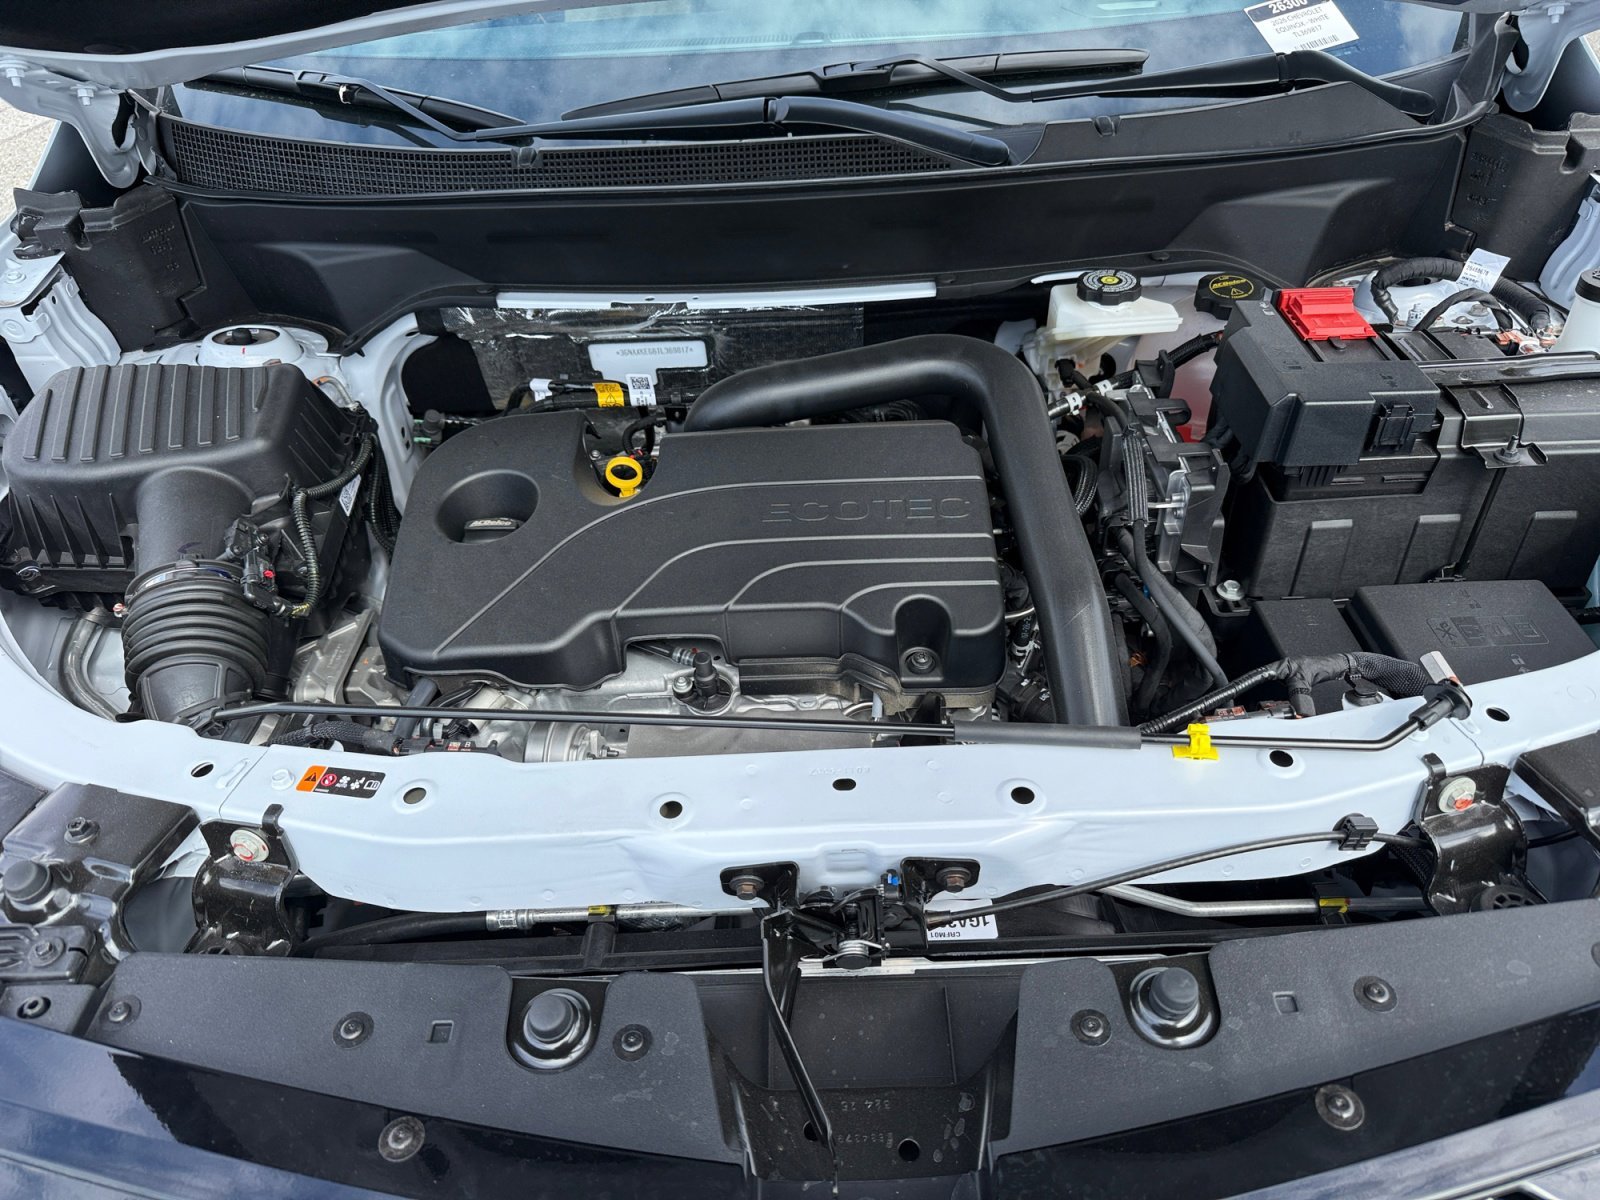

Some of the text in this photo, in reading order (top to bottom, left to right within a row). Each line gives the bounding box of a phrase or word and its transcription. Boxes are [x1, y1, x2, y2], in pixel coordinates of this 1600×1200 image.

[1271, 6, 1323, 26] 2026 CHEVROLET
[1275, 20, 1305, 34] EQUINOX
[1310, 14, 1330, 25] WHITE
[1293, 25, 1323, 37] TL369817
[761, 497, 971, 522] ECOTEC
